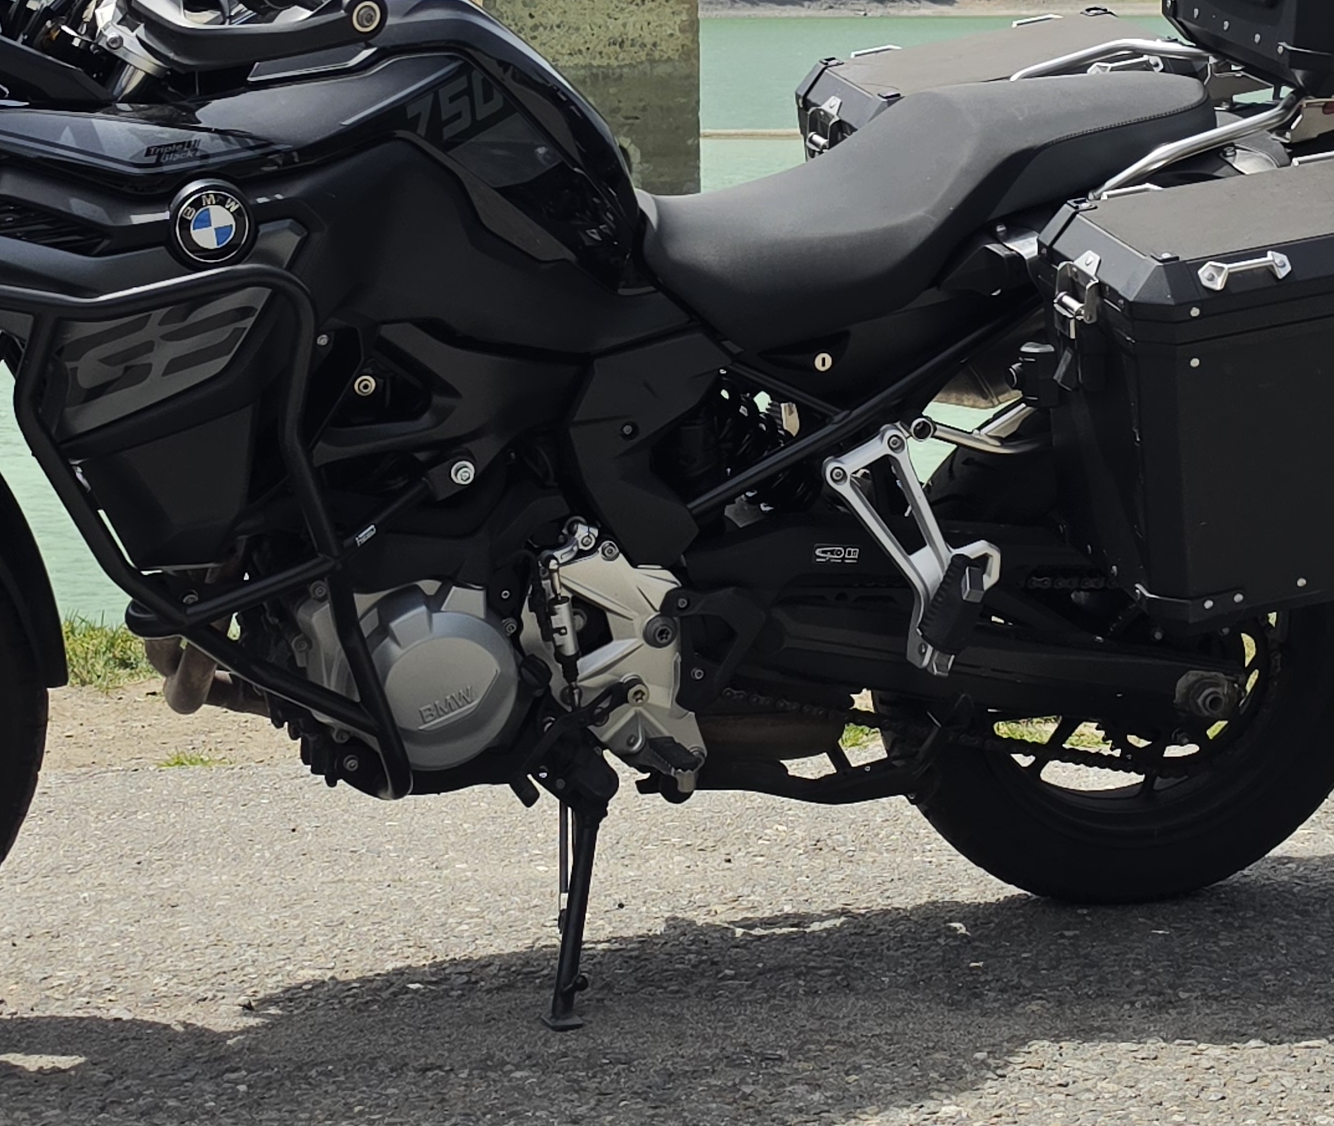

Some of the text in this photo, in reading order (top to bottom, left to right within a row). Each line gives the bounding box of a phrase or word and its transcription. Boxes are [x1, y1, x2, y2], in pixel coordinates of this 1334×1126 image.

[406, 69, 504, 141] 750
[148, 143, 184, 155] Triple
[160, 150, 194, 162] Black
[182, 193, 240, 221] BMW
[419, 686, 473, 724] BMW
